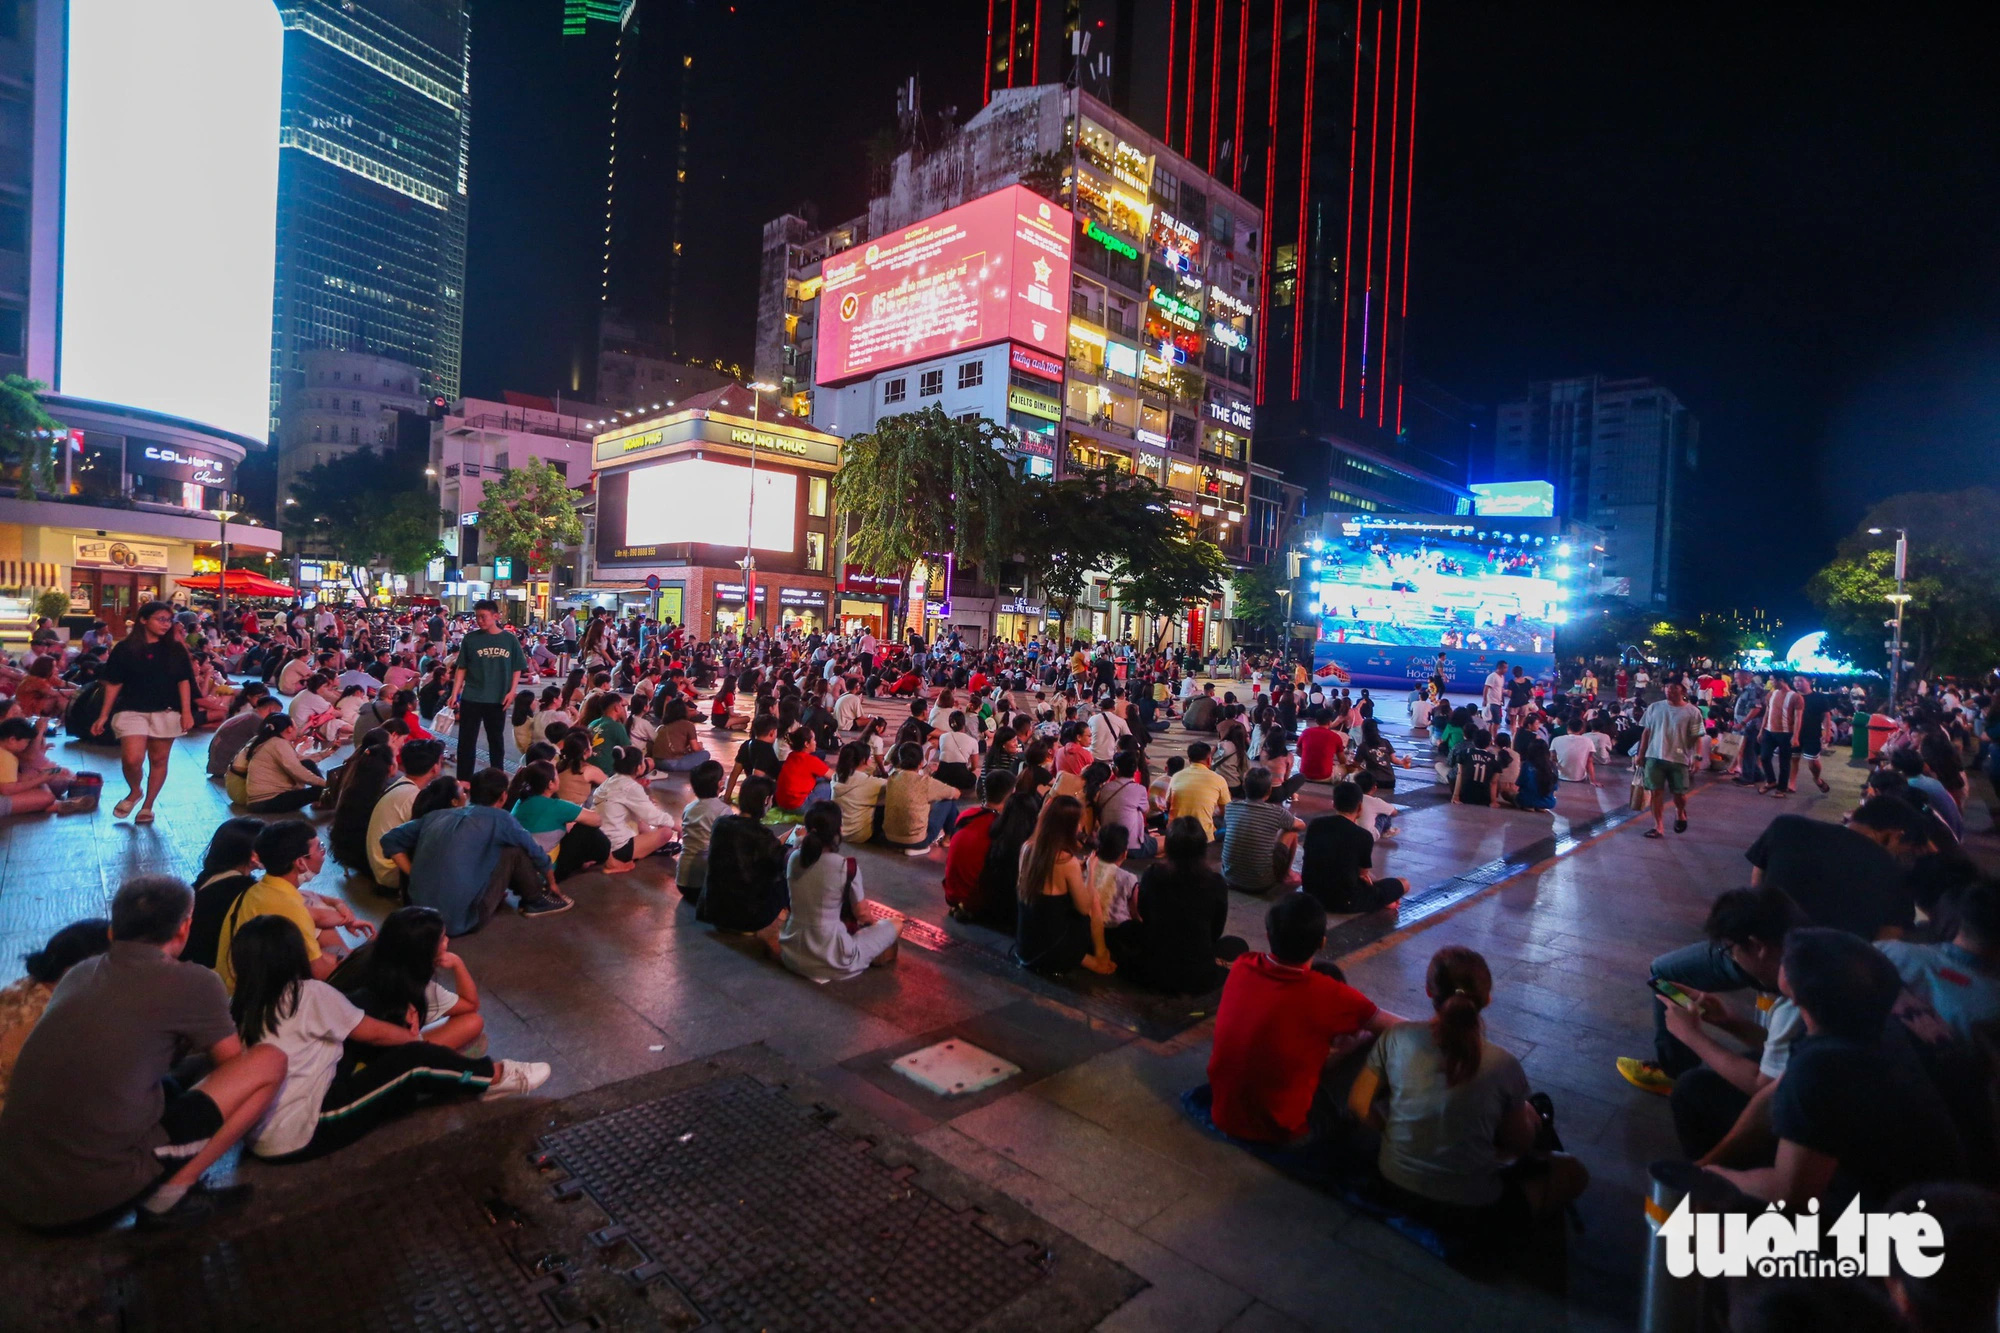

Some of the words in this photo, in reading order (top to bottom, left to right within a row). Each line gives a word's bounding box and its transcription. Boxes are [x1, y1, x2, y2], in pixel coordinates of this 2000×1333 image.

[1160, 211, 1174, 229] THE
[1175, 220, 1199, 243] LETTER
[1160, 308, 1172, 321] THE
[1018, 396, 1033, 408] IELTS
[1211, 403, 1230, 422] THE
[1232, 412, 1251, 430] ONE
[477, 647, 510, 658] PSYCHO
[1473, 763, 1486, 783] 11
